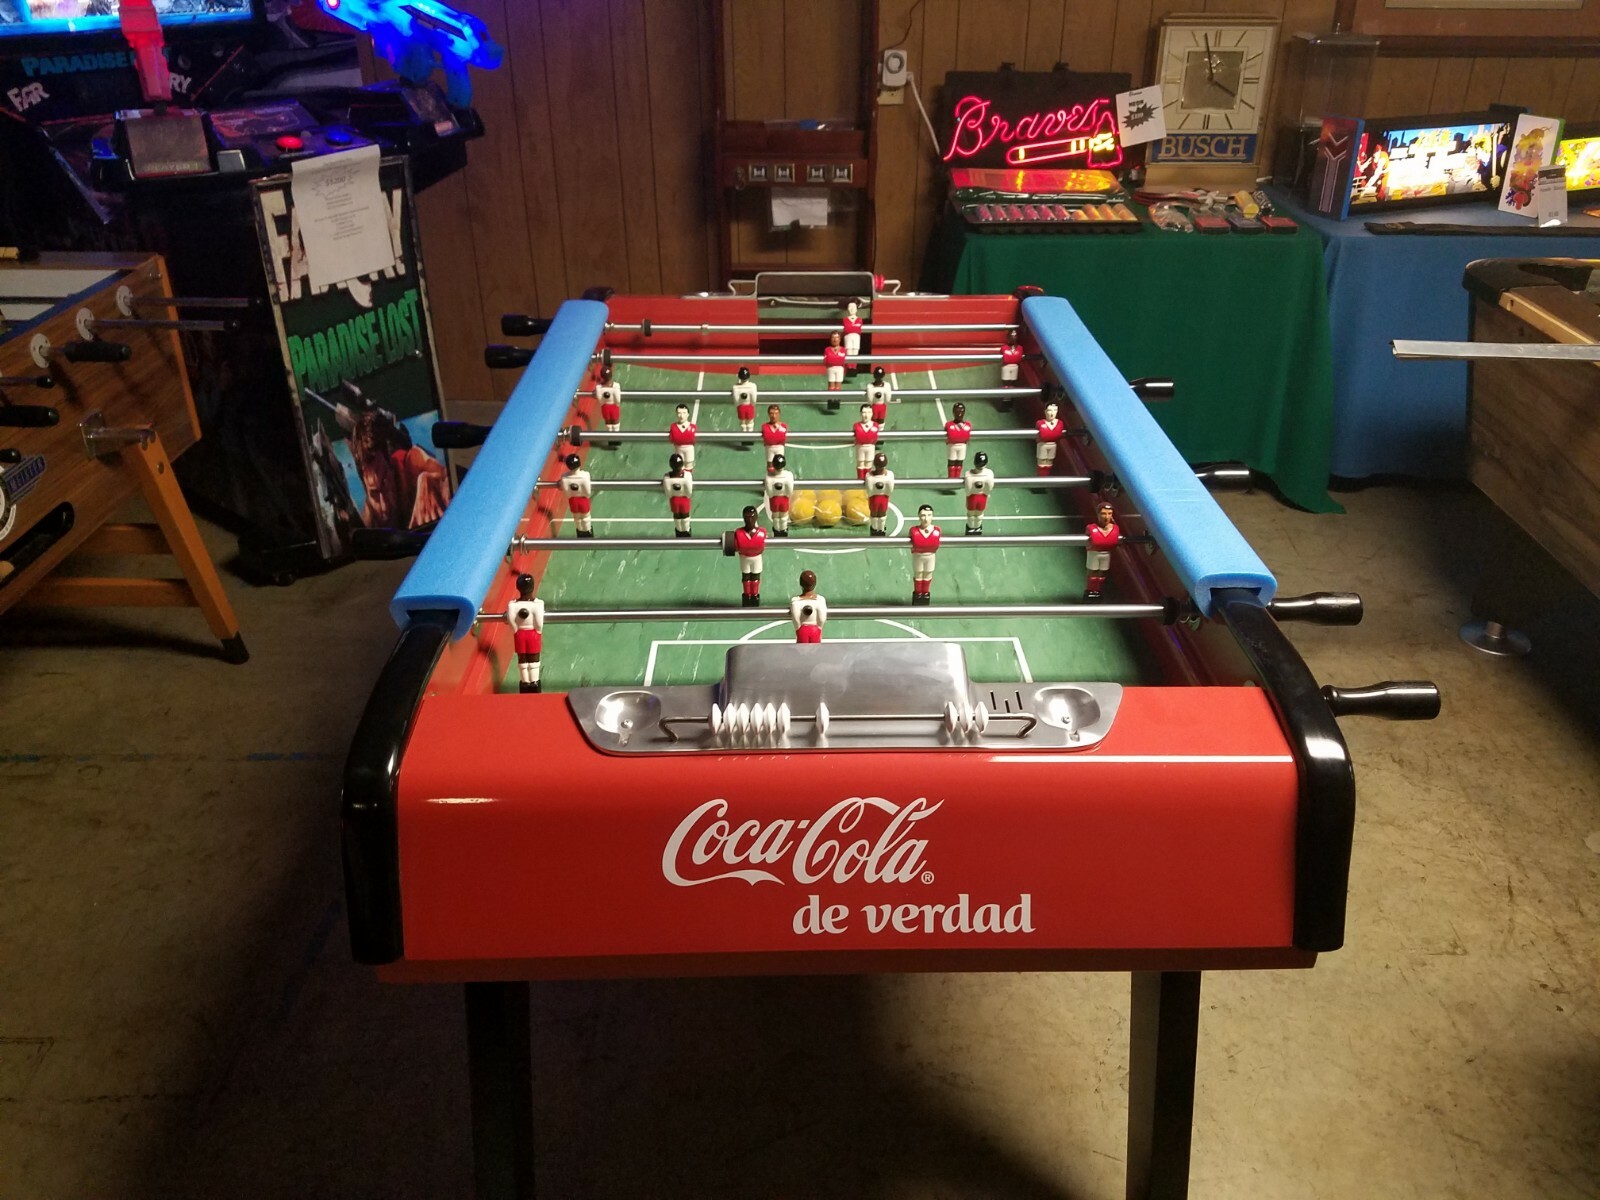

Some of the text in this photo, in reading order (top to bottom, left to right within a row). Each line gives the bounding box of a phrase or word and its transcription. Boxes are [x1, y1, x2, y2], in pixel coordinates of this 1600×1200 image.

[21, 52, 129, 77] PARADISE
[8, 71, 192, 112] FAR RY
[944, 96, 1100, 160] Braves
[1158, 135, 1248, 159] BUSCH
[288, 288, 423, 400] PARADISE LOST
[662, 797, 945, 887] Coca-Cola
[793, 894, 1036, 934] de verdad
